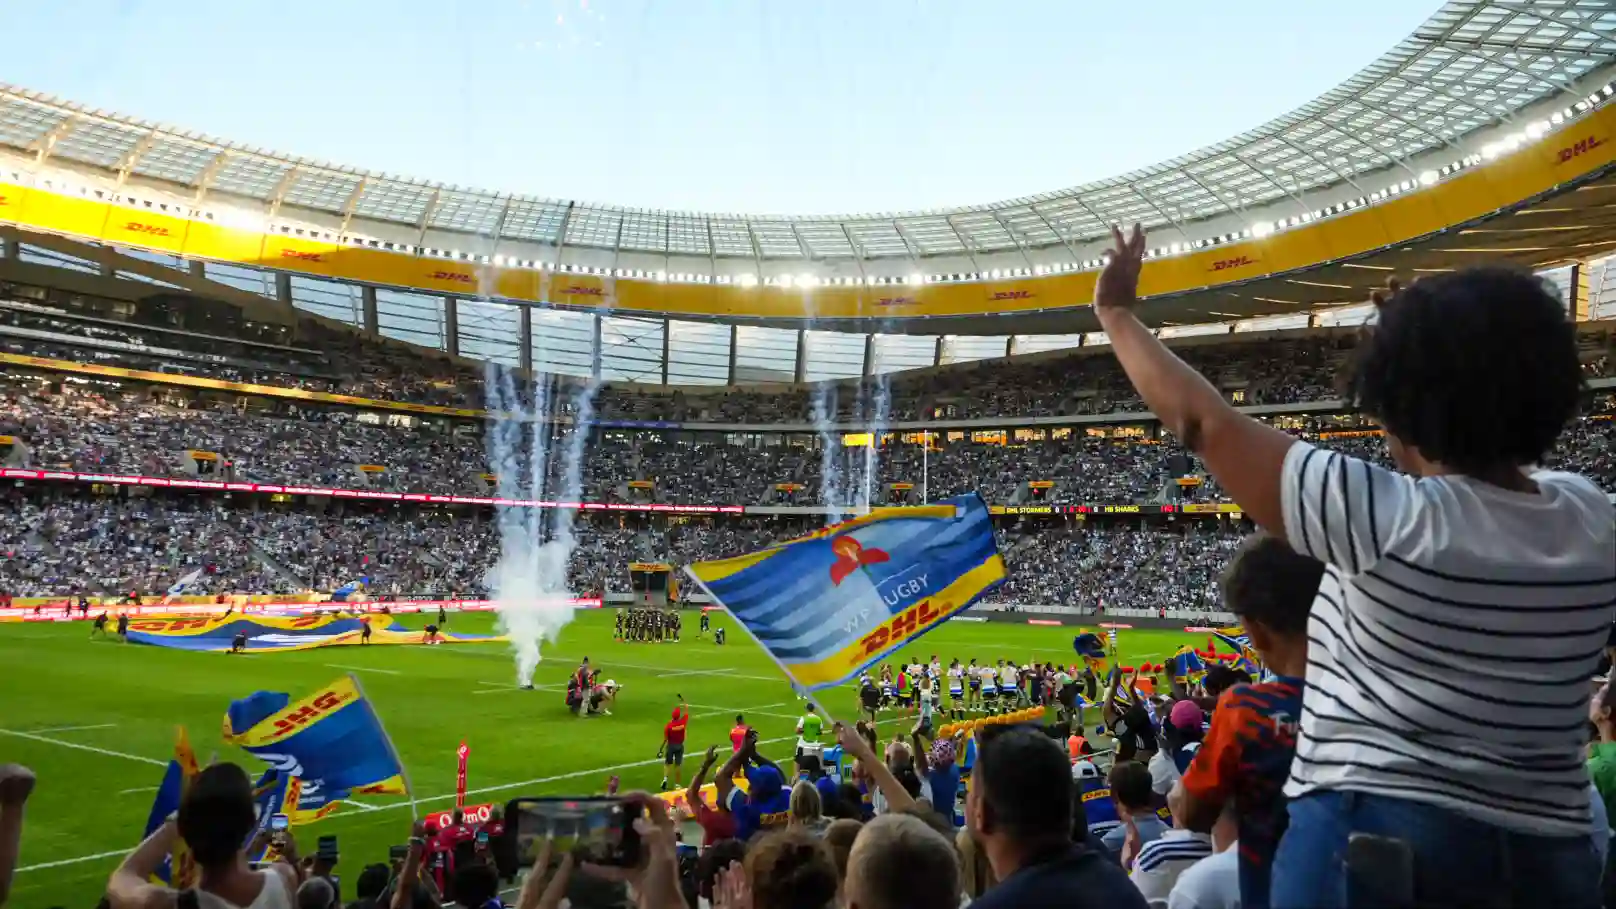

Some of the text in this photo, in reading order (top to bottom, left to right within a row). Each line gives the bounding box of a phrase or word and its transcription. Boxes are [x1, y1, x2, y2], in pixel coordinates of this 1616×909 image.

[1556, 134, 1604, 163] DHL
[1211, 255, 1254, 272] DHL
[434, 270, 474, 283] DHL
[1019, 506, 1052, 514] STORMERS
[1115, 505, 1140, 513] SHARKS
[859, 599, 941, 656] DHL
